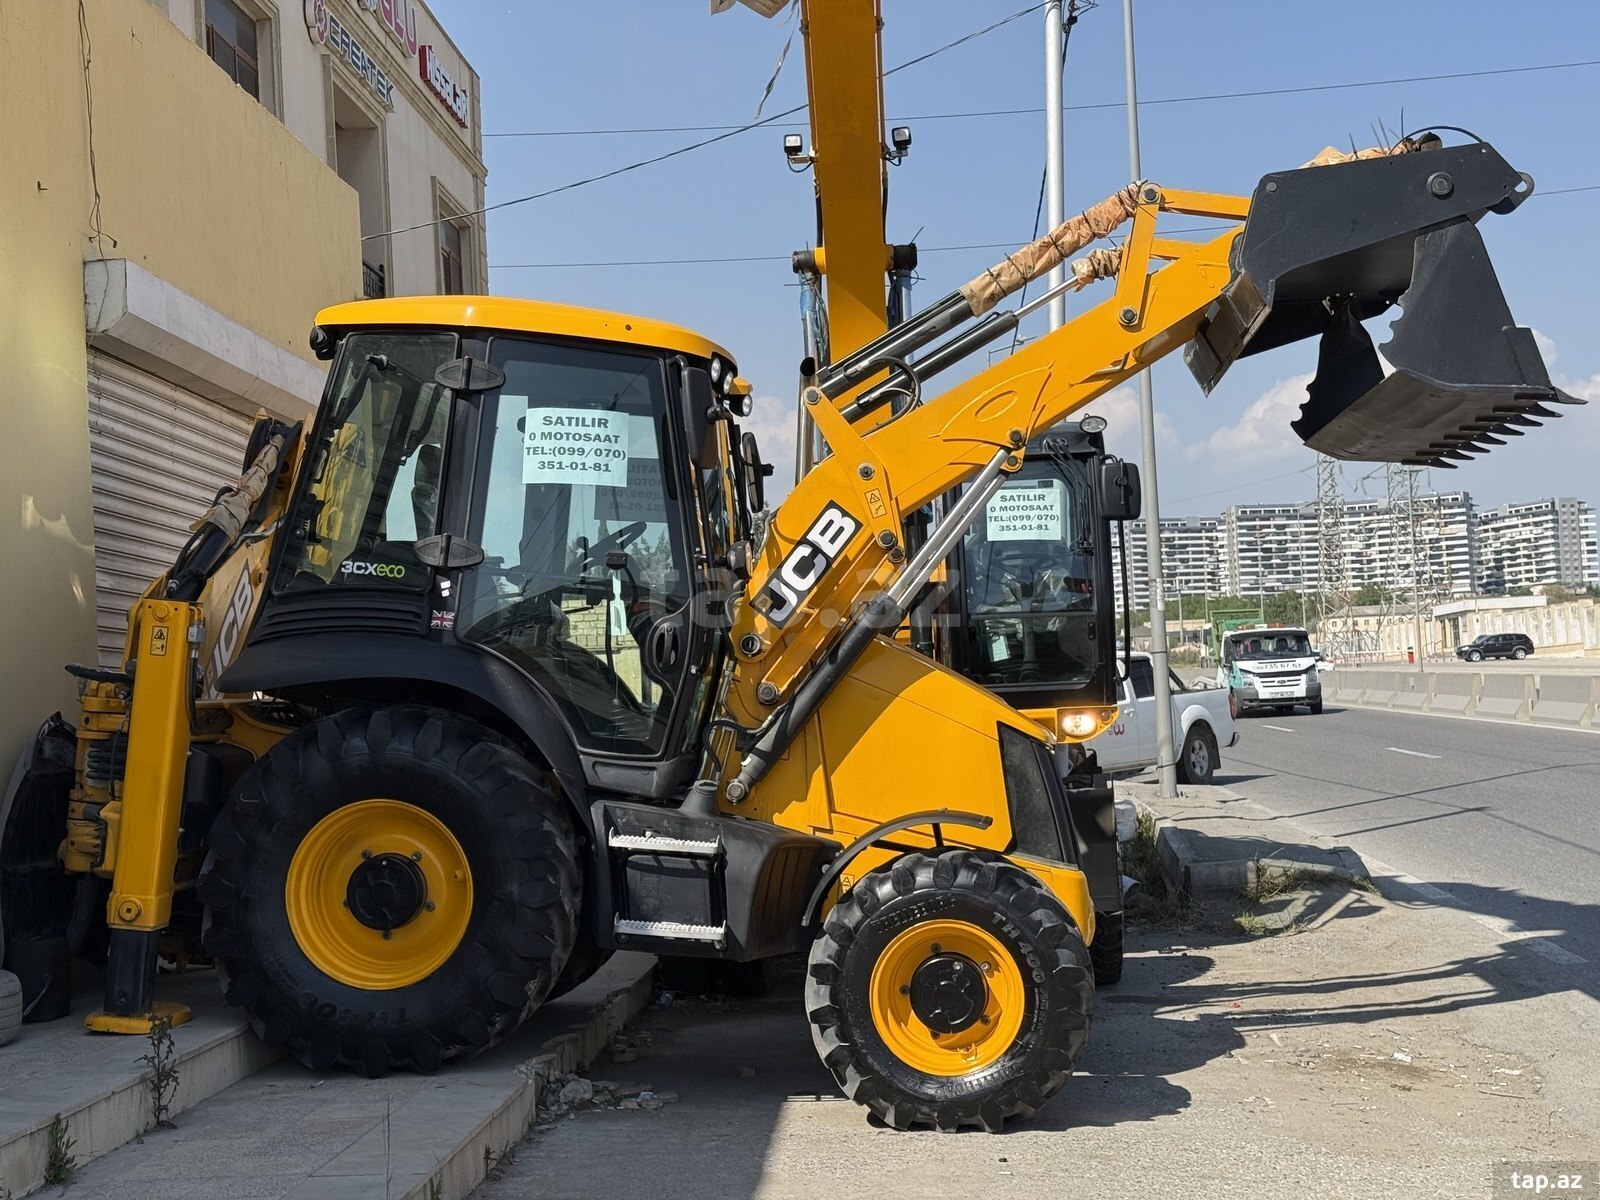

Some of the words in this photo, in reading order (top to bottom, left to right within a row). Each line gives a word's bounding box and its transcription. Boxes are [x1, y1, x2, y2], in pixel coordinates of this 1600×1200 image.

[542, 415, 609, 428] SATILIR
[529, 432, 537, 441] 0
[540, 431, 621, 444] MOTOSAAT
[525, 446, 627, 461] TEL:(099/070)
[538, 460, 612, 473] 351-01-81
[1000, 493, 1046, 503] SATILIR
[999, 504, 1055, 512] MOTOSAAT
[988, 514, 1060, 522] TEL:(099/070)
[998, 523, 1050, 532] 351-01-81
[341, 560, 406, 578] 3CXeco
[768, 508, 856, 622] JCB
[209, 568, 252, 699] JCB
